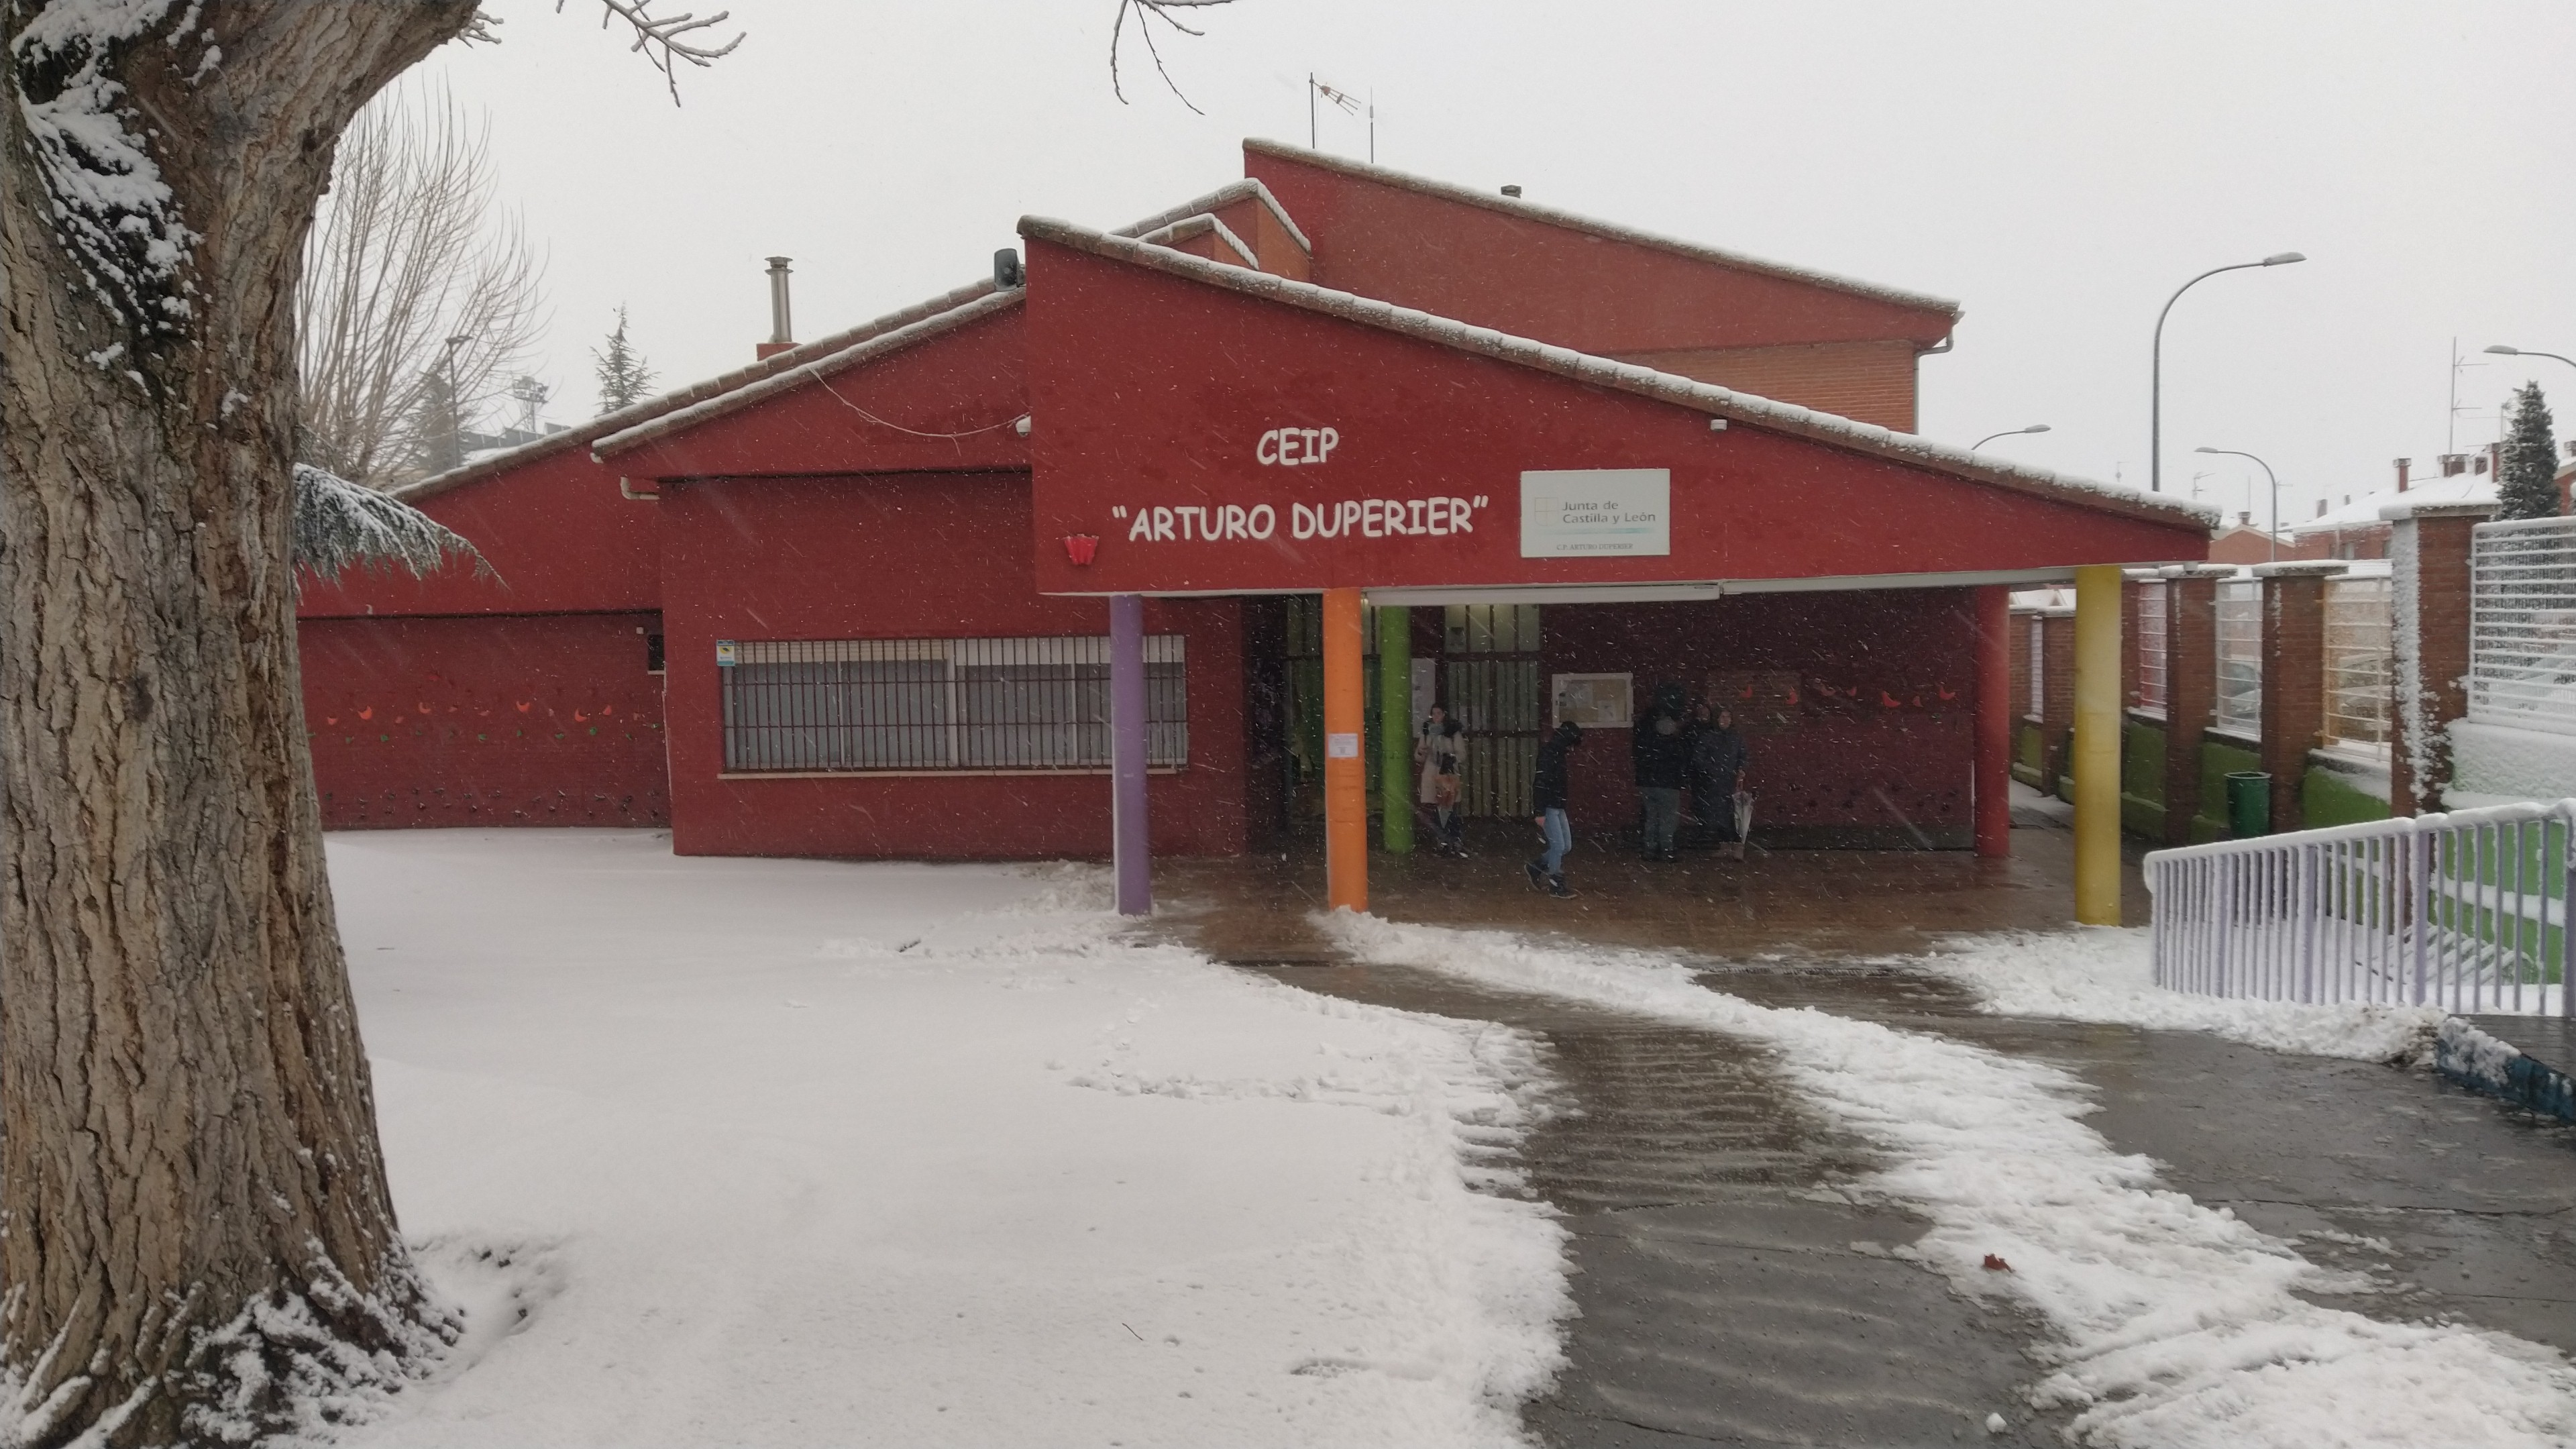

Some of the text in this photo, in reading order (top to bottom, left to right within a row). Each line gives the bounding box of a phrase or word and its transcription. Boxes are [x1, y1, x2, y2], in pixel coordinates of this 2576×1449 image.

[1256, 427, 1339, 466] CEIP
[1562, 500, 1619, 511] Junta de
[1562, 512, 1656, 525] Castilla y León
